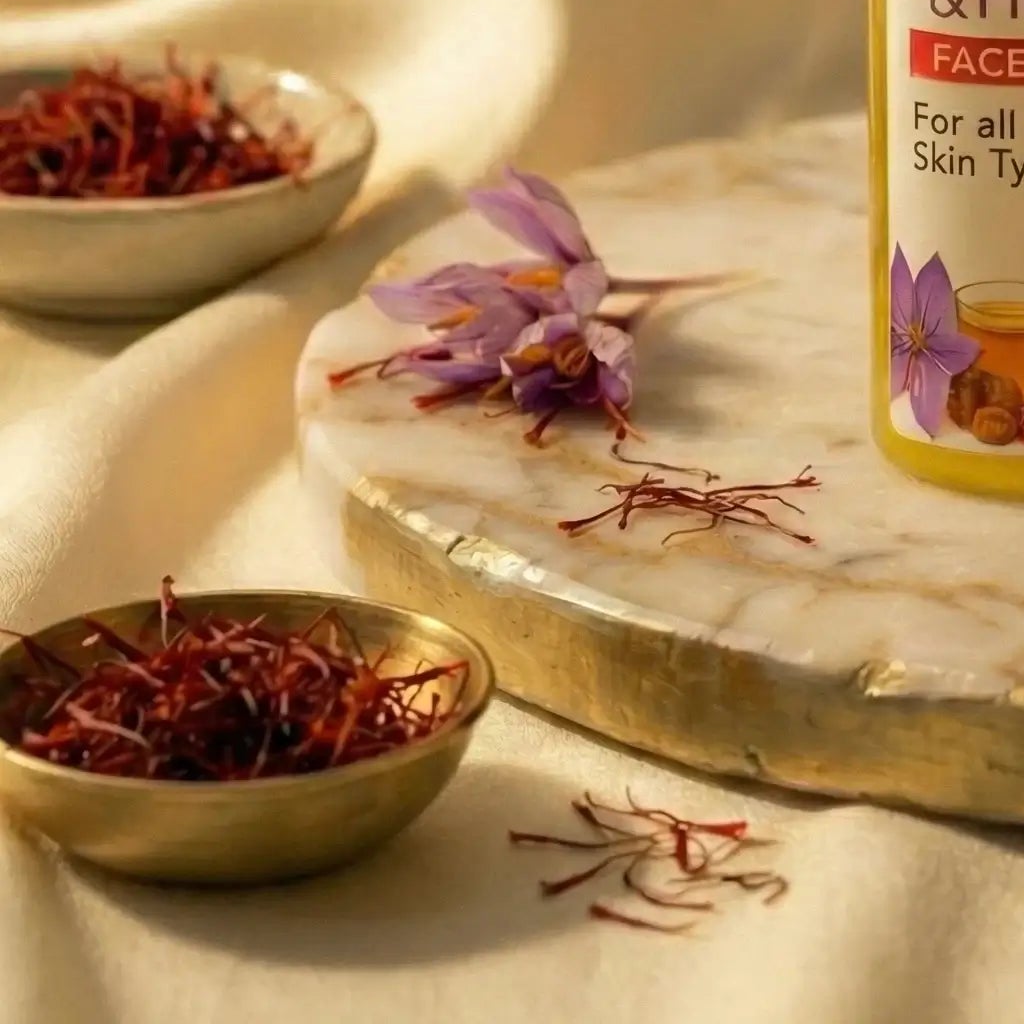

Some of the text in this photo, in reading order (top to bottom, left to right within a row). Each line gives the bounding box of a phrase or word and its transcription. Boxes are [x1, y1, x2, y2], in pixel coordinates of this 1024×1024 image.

[913, 101, 1016, 140] For all
[912, 140, 976, 176] Skin
